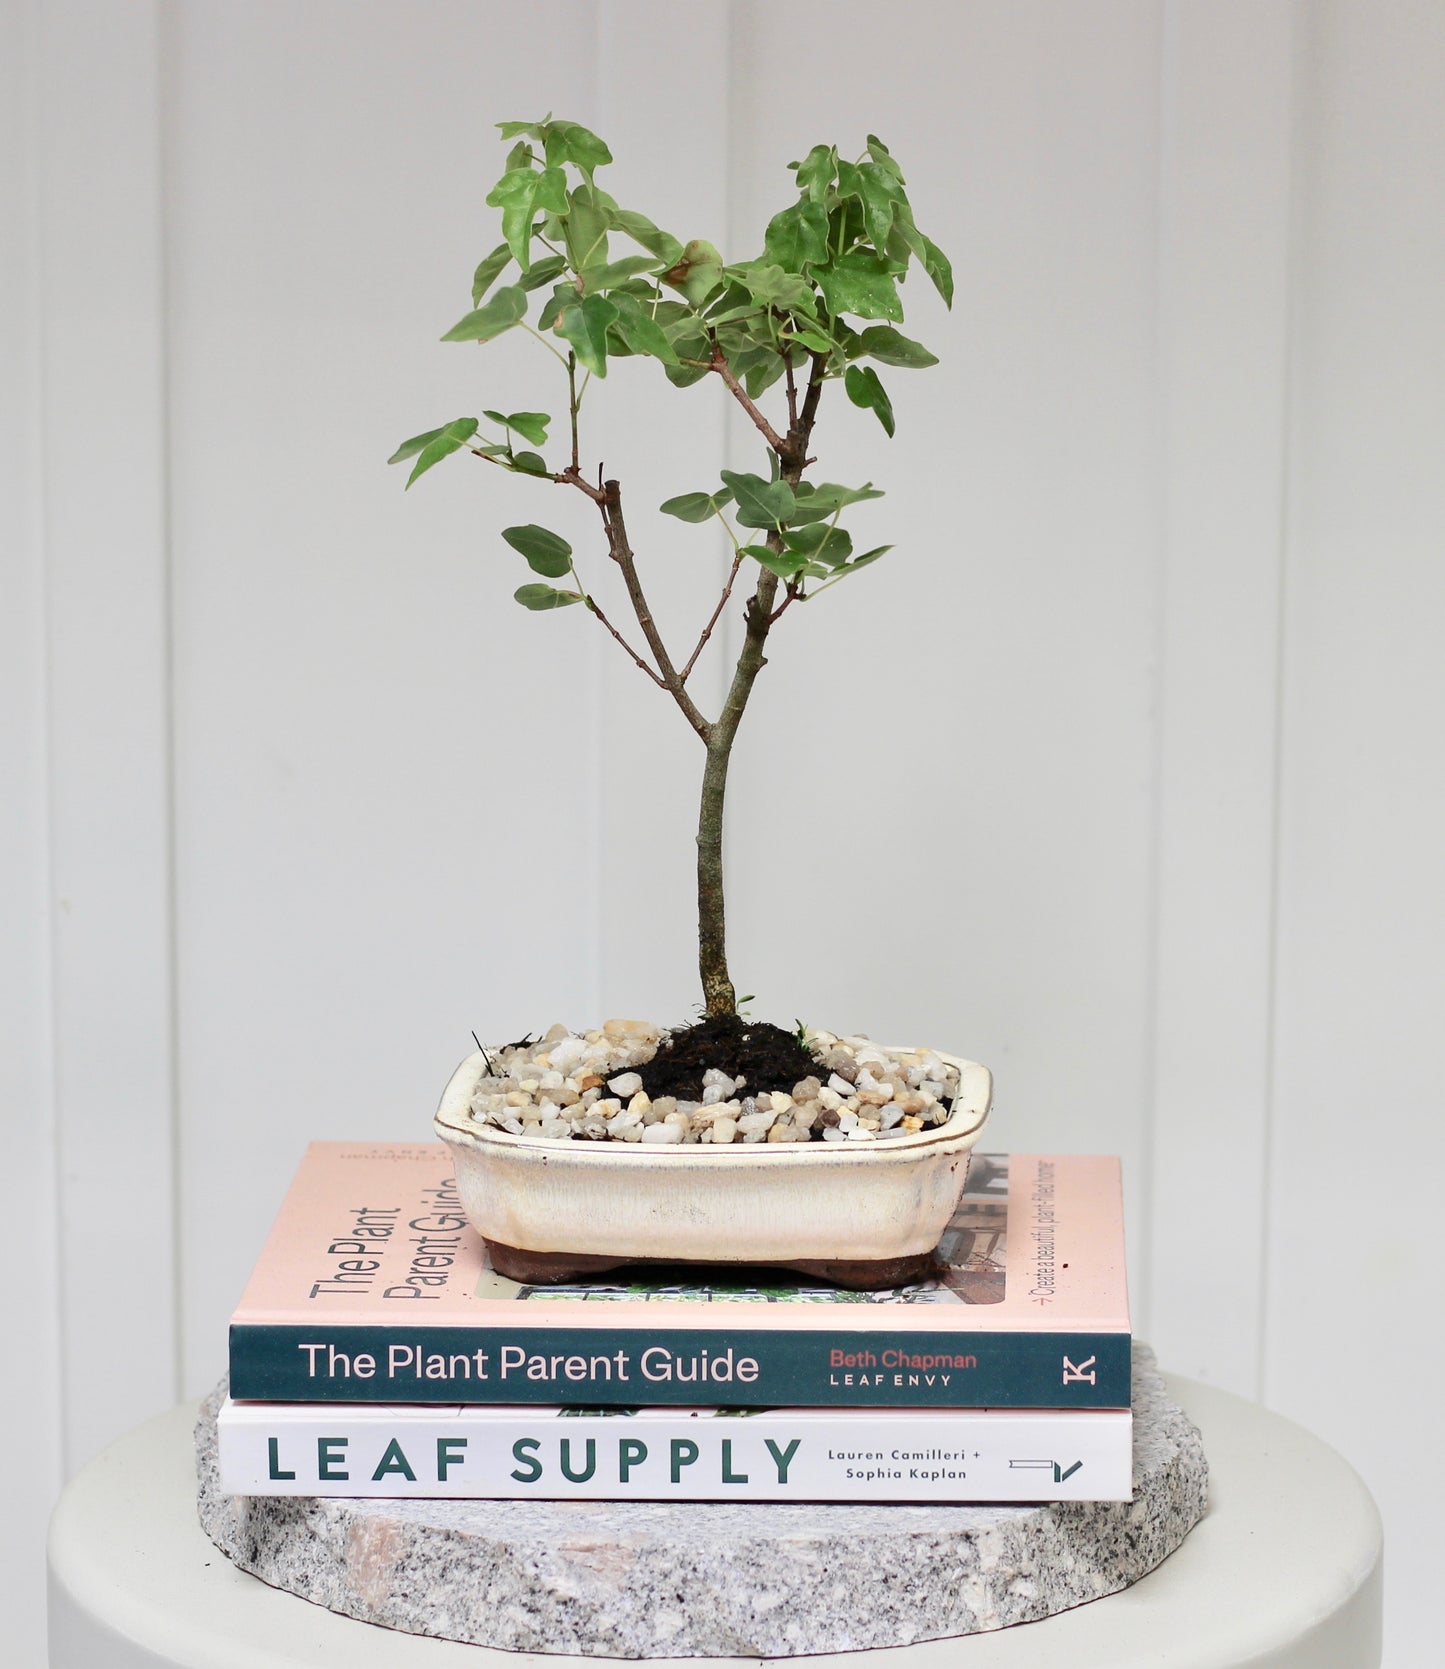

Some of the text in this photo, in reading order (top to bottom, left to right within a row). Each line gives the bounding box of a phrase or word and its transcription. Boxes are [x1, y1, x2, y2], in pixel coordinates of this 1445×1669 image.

[328, 1207, 401, 1254] Plant
[309, 1260, 380, 1298] The
[382, 1236, 461, 1299] Parent
[1030, 1268, 1056, 1295] Create
[298, 1344, 760, 1382] The Plant Parent Guide
[830, 1349, 977, 1371] Beth Chapman
[1063, 1355, 1096, 1386] K
[830, 1374, 952, 1386] LEAF ENVY
[268, 1437, 802, 1484] LEAF SUPPLY
[828, 1449, 884, 1460] Lauren
[891, 1449, 966, 1460] Camilleri
[846, 1468, 967, 1480] Sophia Kaplan
